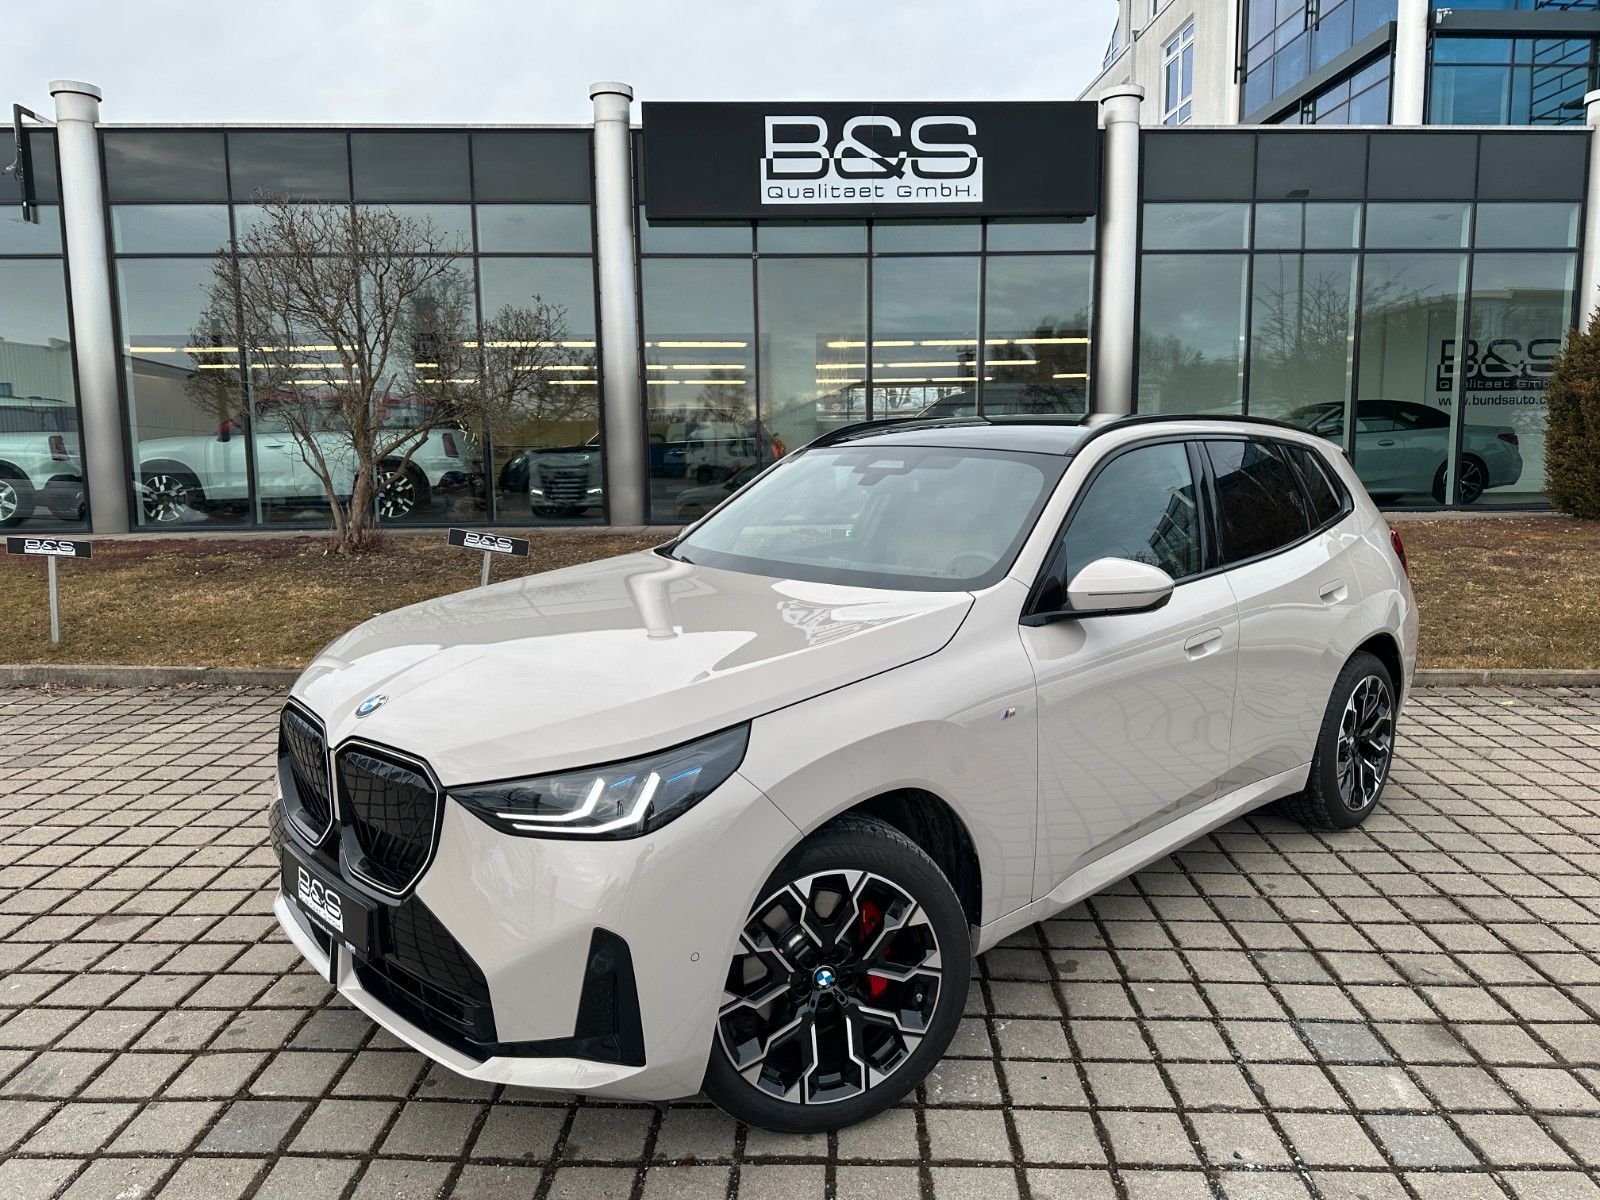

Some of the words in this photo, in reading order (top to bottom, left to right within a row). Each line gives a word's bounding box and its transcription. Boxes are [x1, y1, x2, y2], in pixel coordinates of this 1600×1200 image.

[764, 115, 978, 180] B&S
[767, 183, 885, 199] Qualitaet
[896, 183, 977, 198] GmbH.
[1439, 379, 1510, 389] Qlitaet
[24, 539, 74, 552] B&S
[464, 532, 512, 549] B&S
[298, 865, 342, 921] B&S
